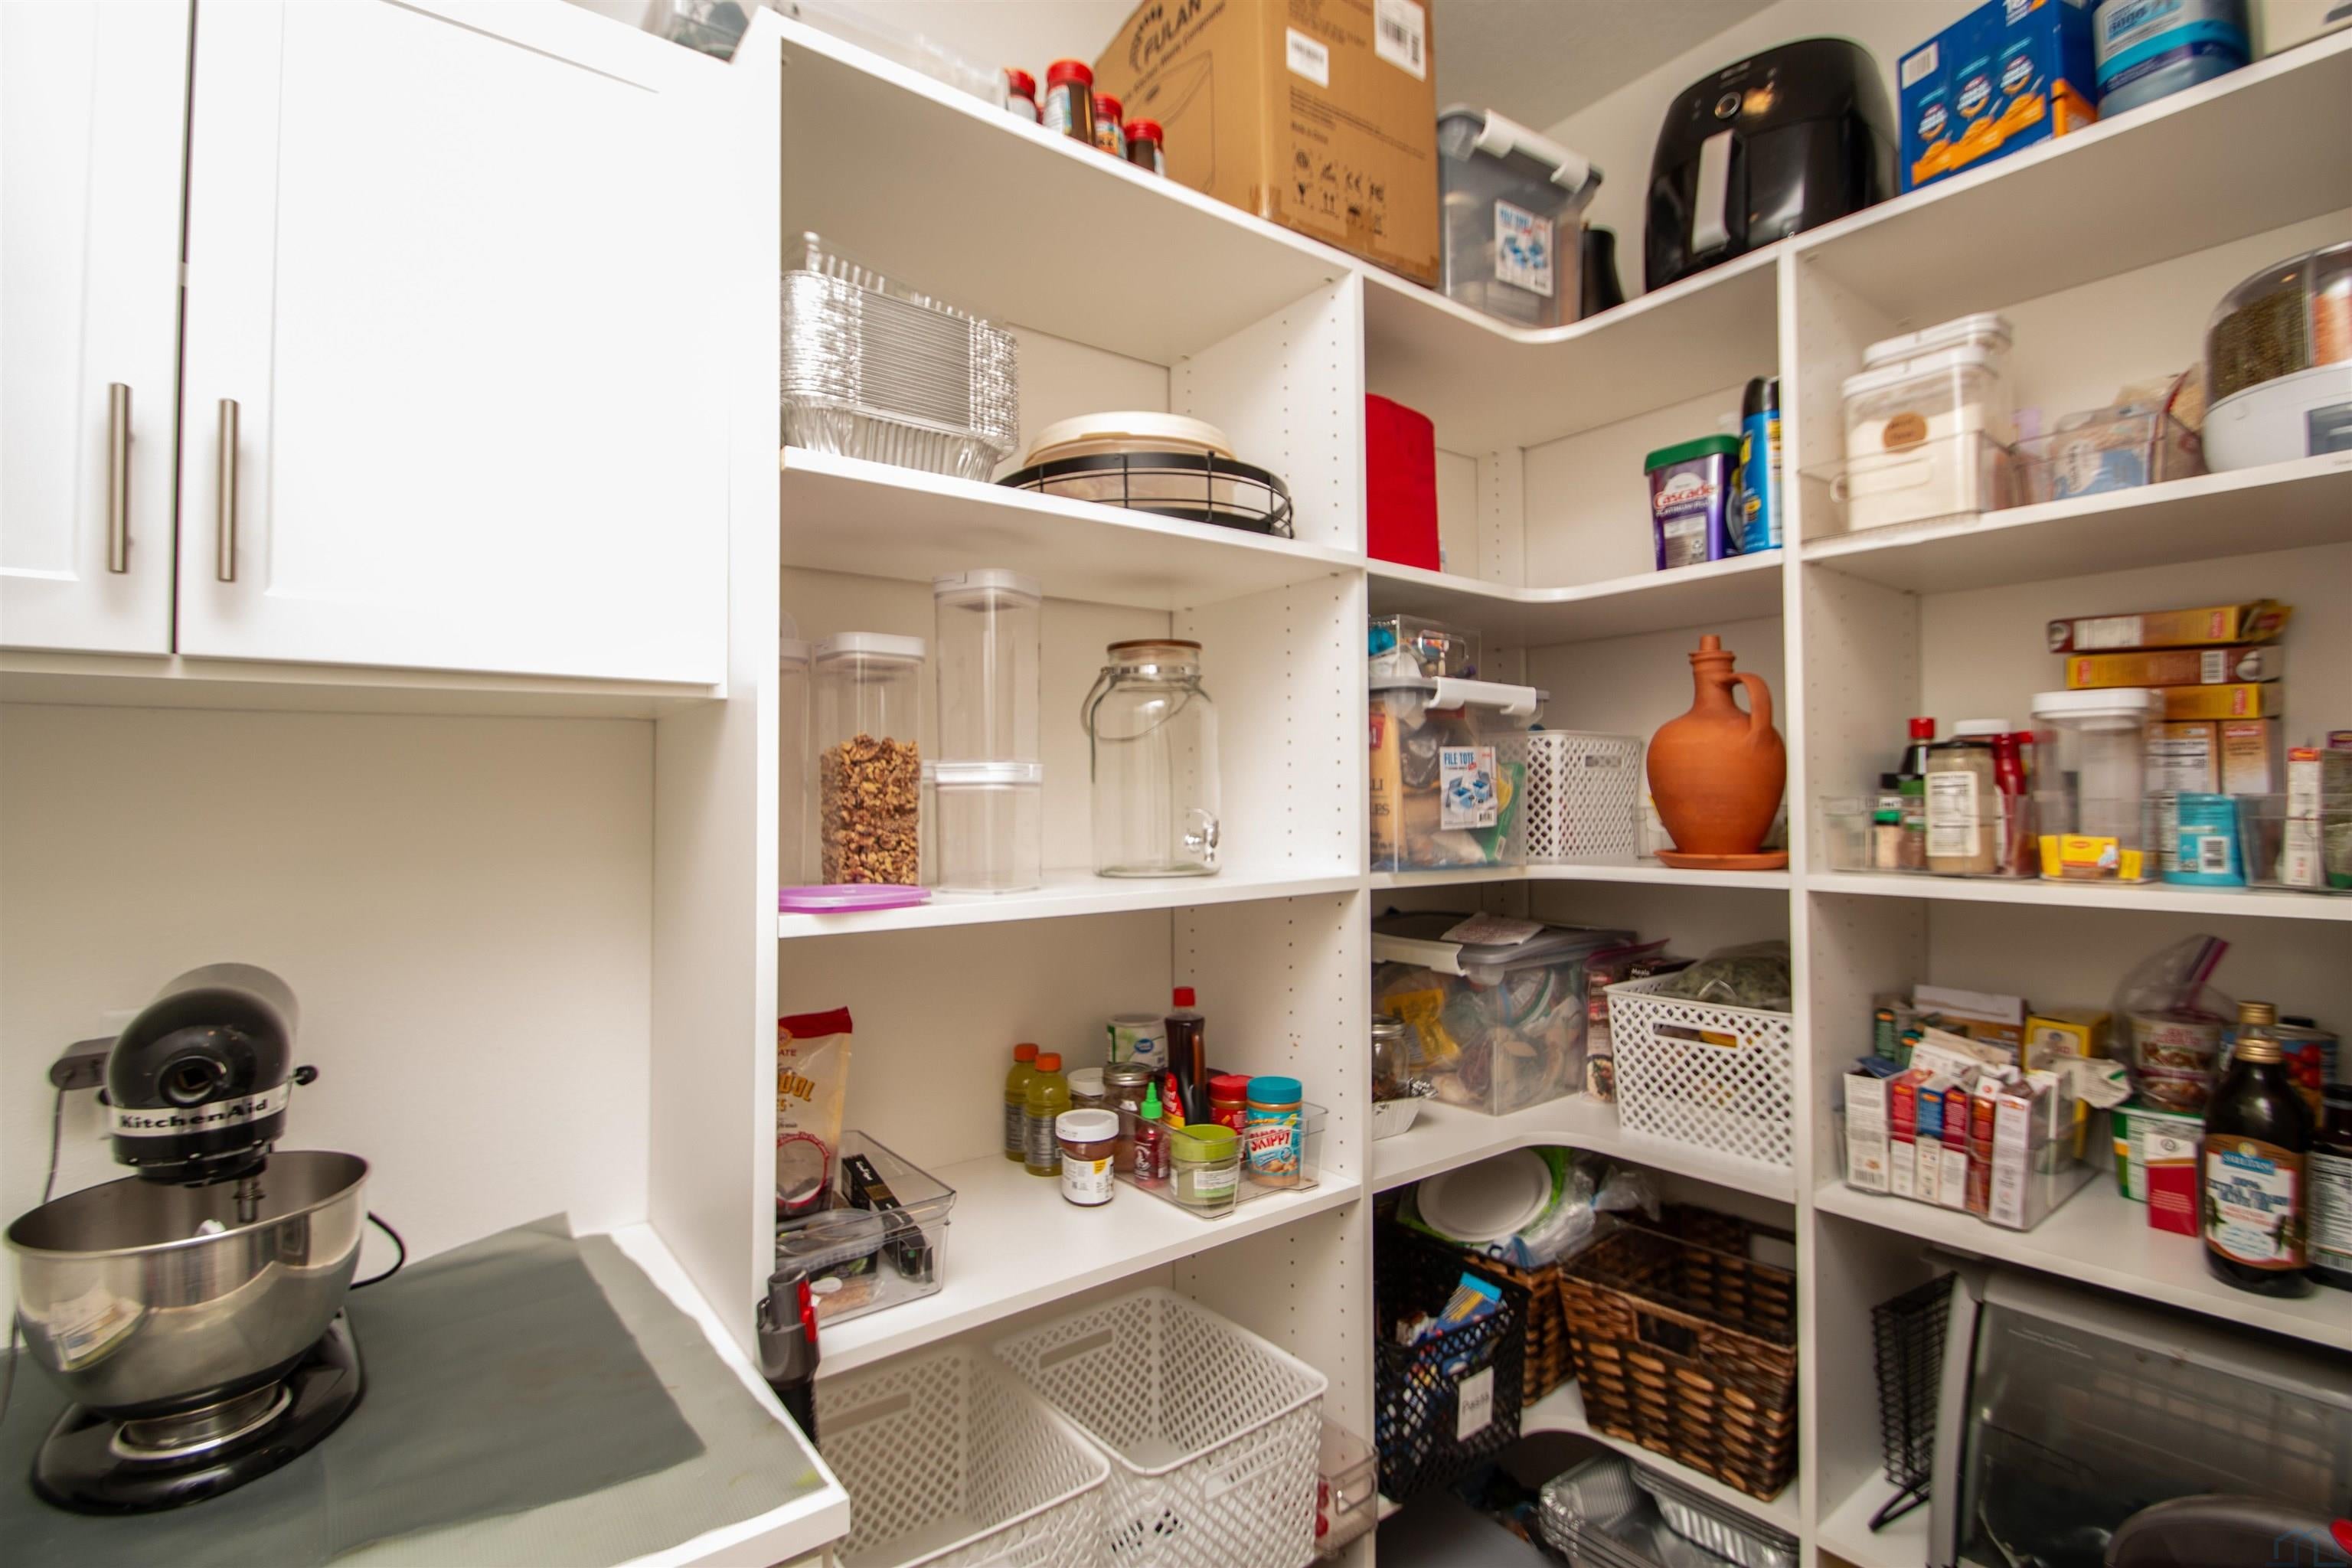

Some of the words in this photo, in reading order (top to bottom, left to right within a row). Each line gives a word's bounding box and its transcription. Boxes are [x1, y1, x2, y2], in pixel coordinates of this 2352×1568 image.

[1654, 483, 1717, 510] Cascade
[1444, 752, 1458, 766] FILE
[1459, 751, 1475, 766] TOTE
[120, 1099, 268, 1129] KitchenAid
